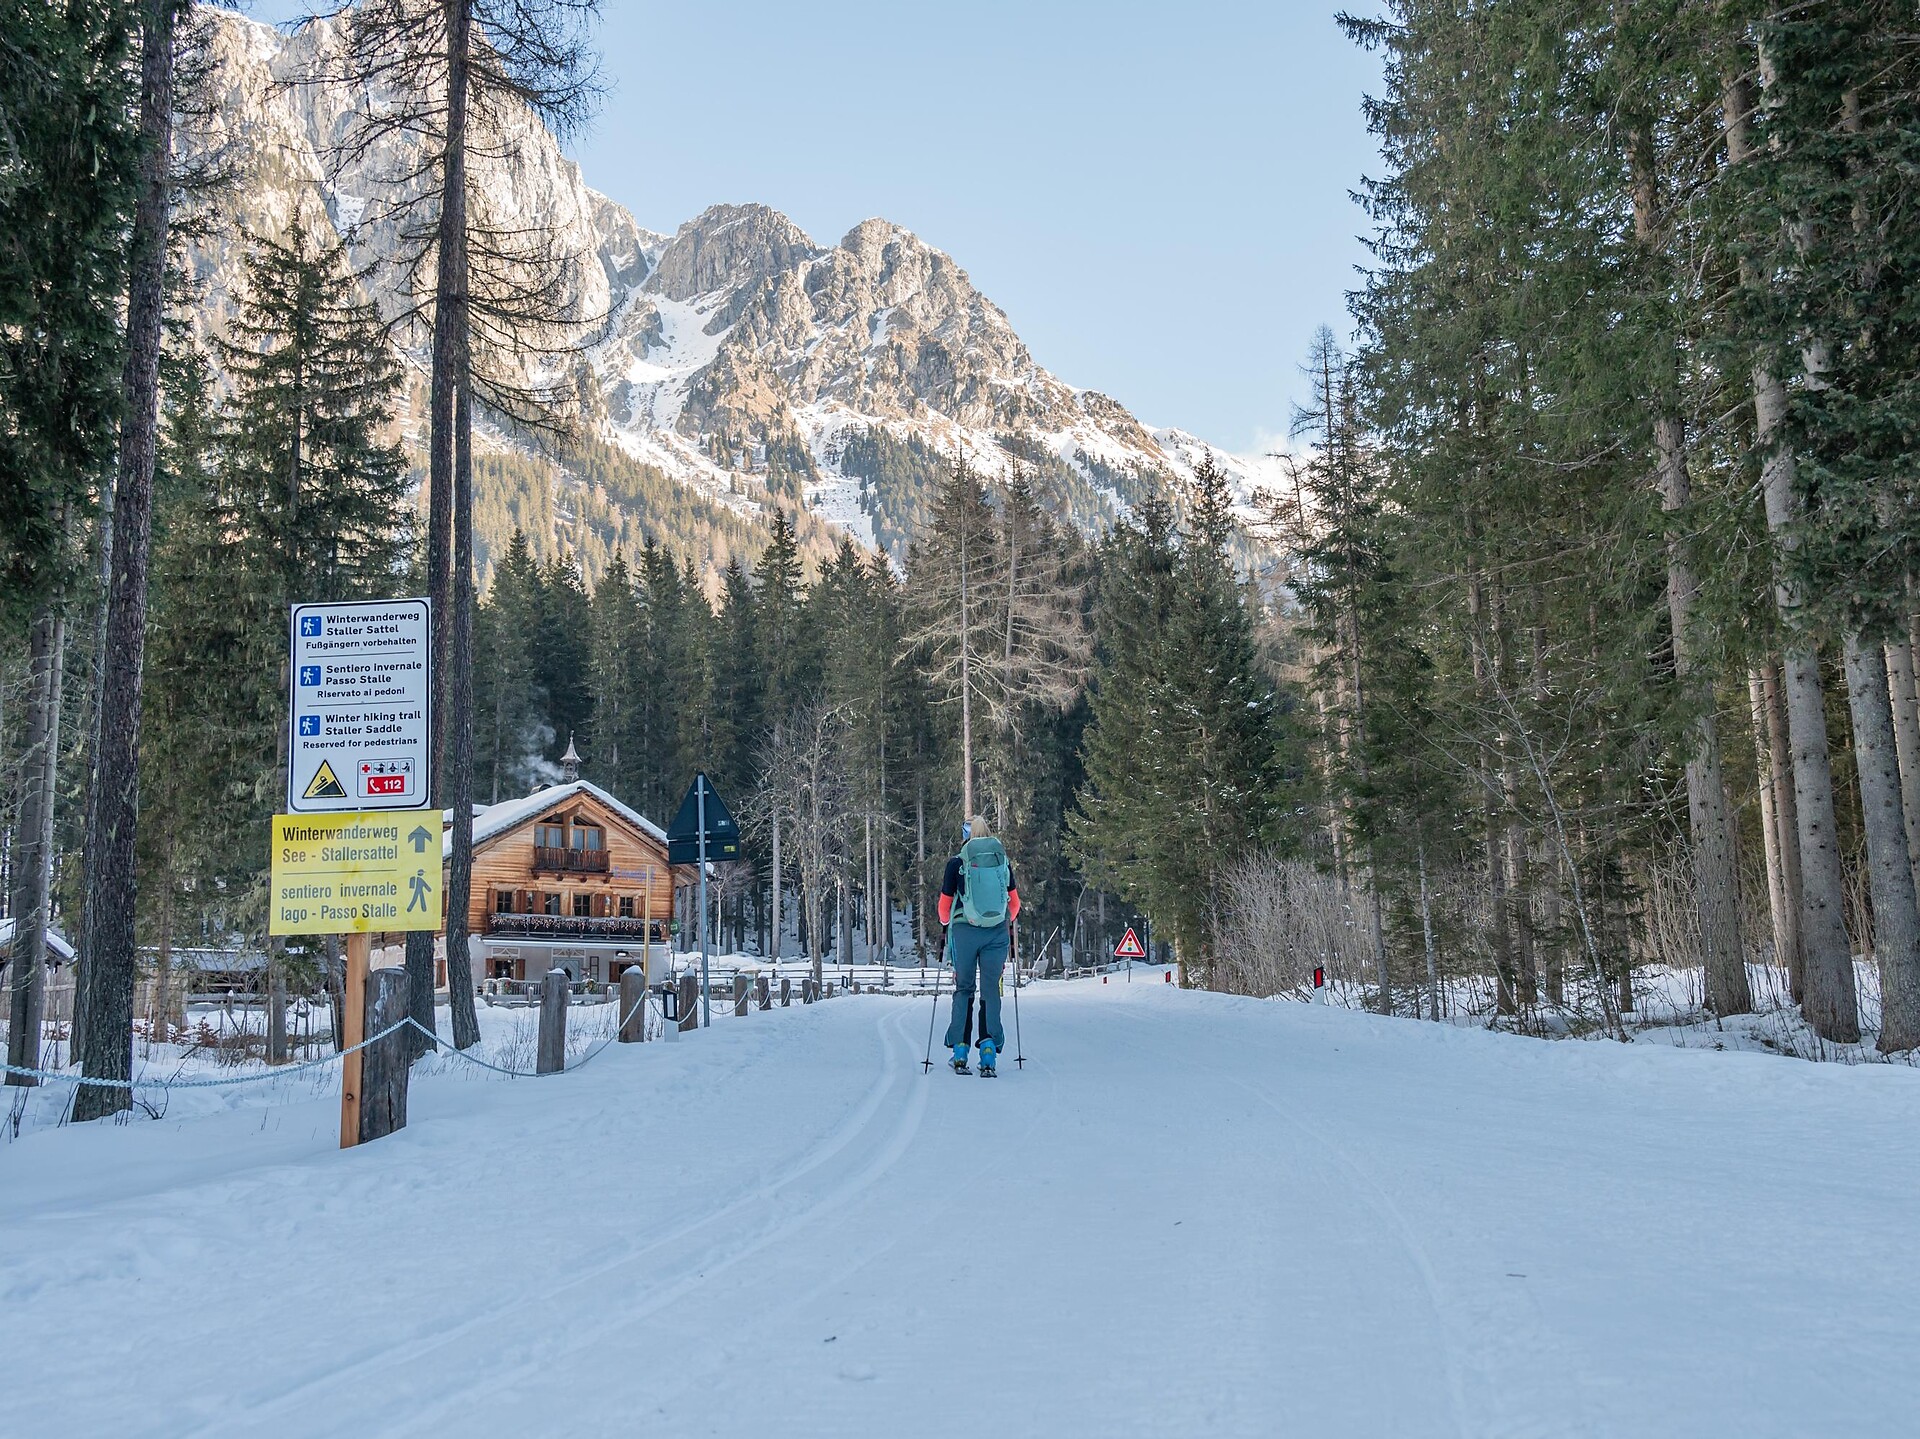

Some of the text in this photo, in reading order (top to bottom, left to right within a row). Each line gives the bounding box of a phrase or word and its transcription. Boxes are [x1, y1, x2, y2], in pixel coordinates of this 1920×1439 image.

[326, 612, 420, 624] Winterwanderweg
[326, 624, 399, 636] Staller Sattel
[306, 637, 417, 650] Fußgängern vorbehalten
[326, 661, 422, 674] Sentiero invernale
[325, 674, 392, 686] Passo Stalle
[317, 687, 405, 698] Riservato ai pedoni
[325, 710, 422, 723] Winter hiking trail
[325, 724, 402, 736] Staller Saddle
[303, 737, 418, 749] Reserved for pedestrians
[383, 780, 402, 790] 112
[282, 825, 398, 842] Winterwanderweg
[282, 848, 306, 863] See
[321, 845, 398, 862] Stallersattel
[281, 882, 397, 899] sentiero invernale
[281, 906, 308, 923] lago
[321, 905, 358, 920] Passo
[361, 903, 397, 919] Stalle
